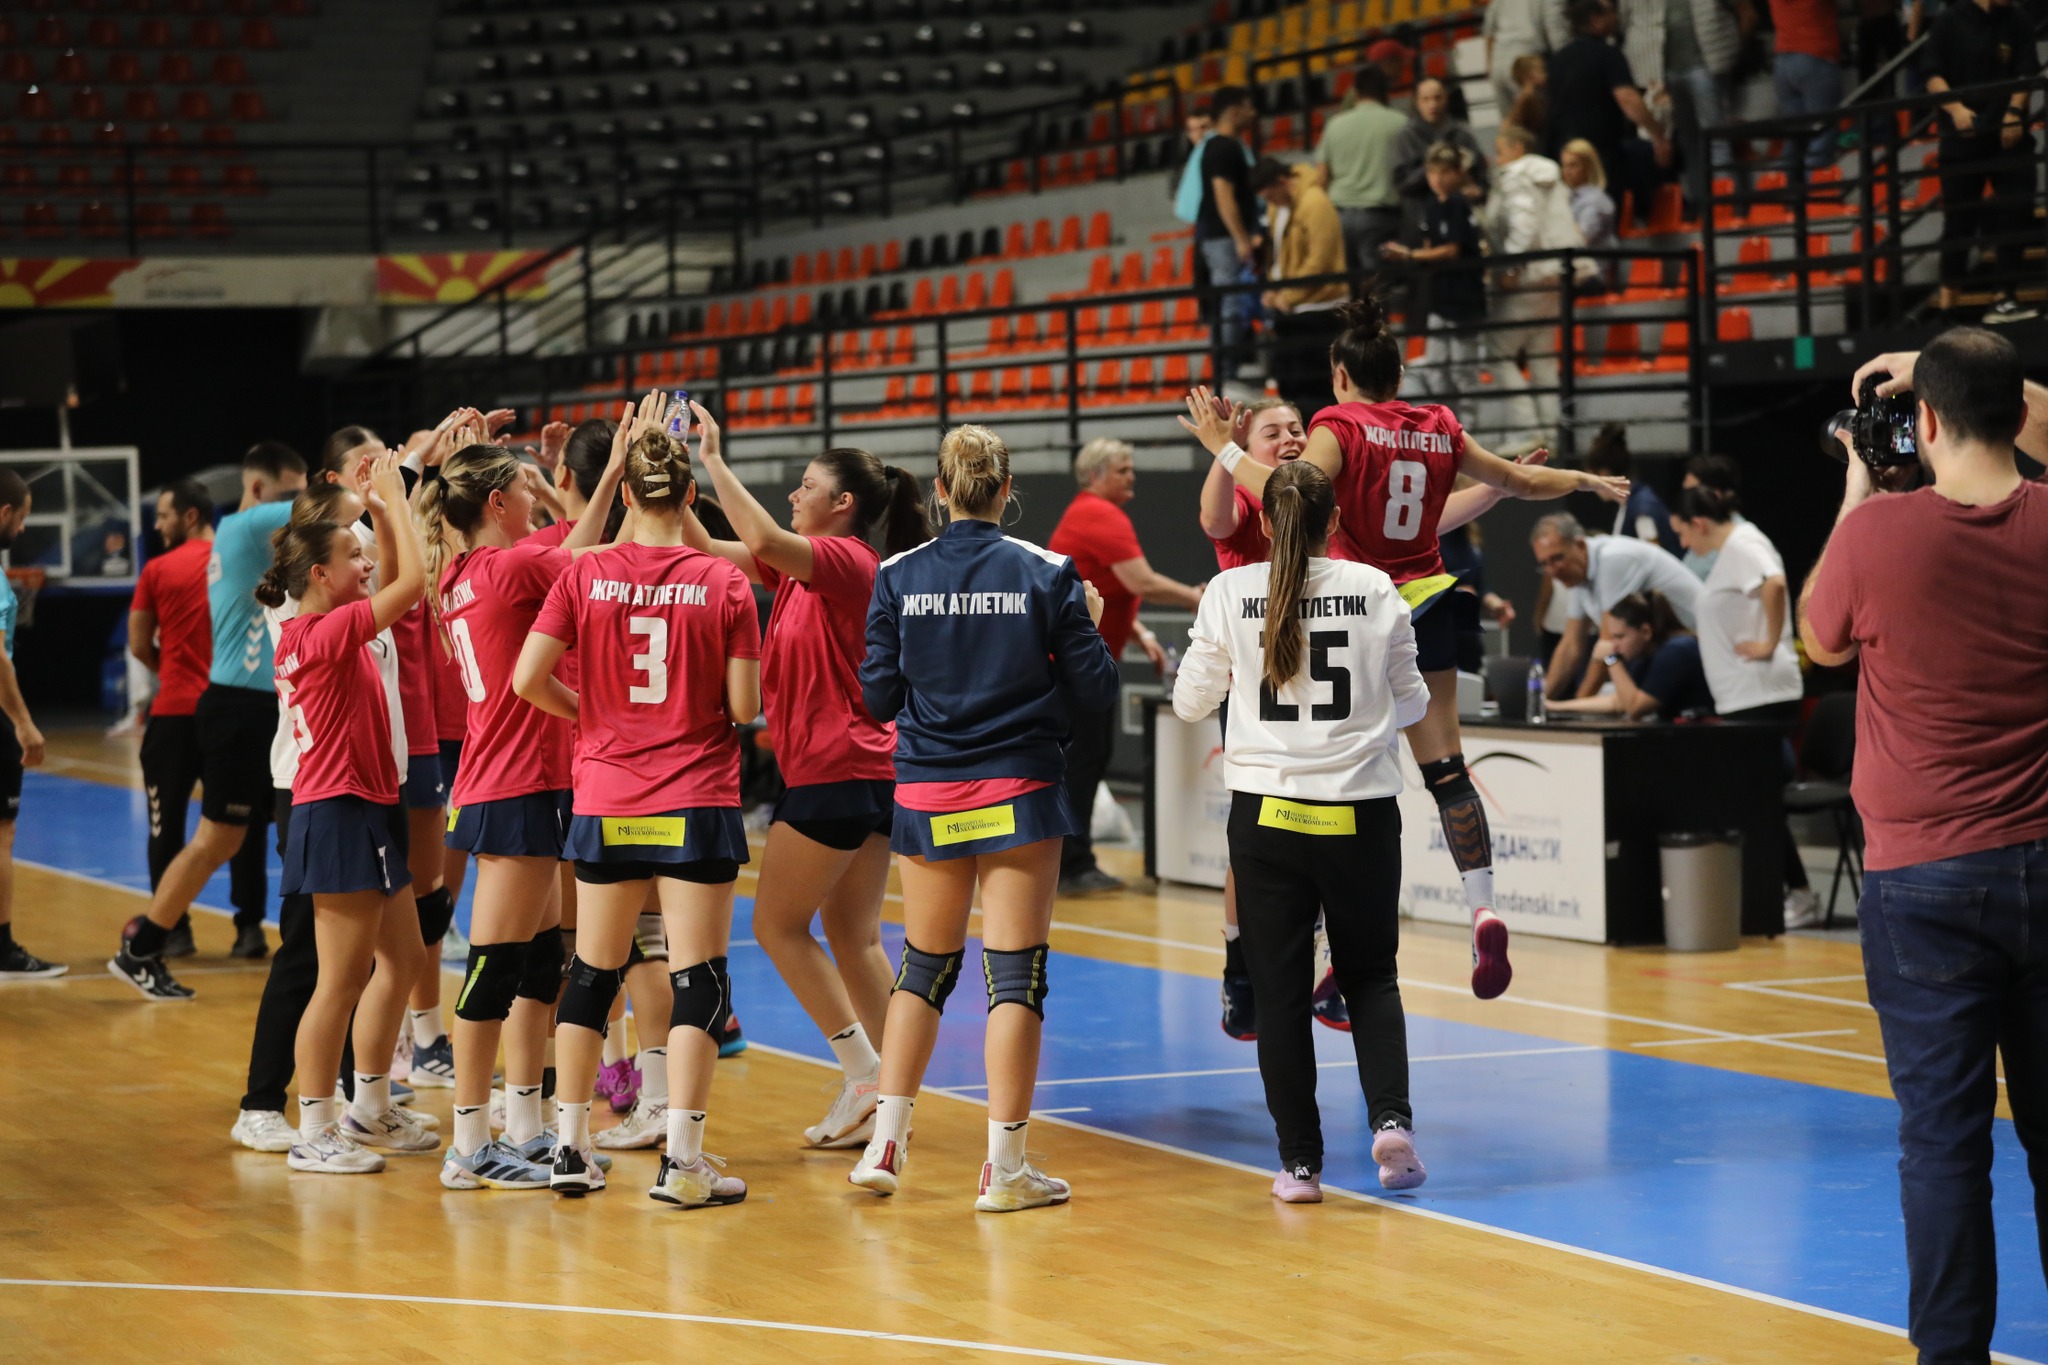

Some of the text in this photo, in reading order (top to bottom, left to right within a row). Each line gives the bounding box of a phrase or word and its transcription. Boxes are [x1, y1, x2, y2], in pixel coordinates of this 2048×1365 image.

[1364, 424, 1397, 449] ЖРК
[1383, 460, 1427, 541] 8
[589, 579, 708, 606] ЖРК АТЛЕТИК
[902, 592, 1027, 616] ЖРК АТЛЕТИК
[1298, 595, 1367, 619] ТЛЕТИК
[629, 616, 668, 704] 3
[960, 821, 1000, 833] NEUROMEDICA
[1290, 811, 1319, 821] HOSPITAL
[1290, 816, 1338, 826] NEUROMEDICA
